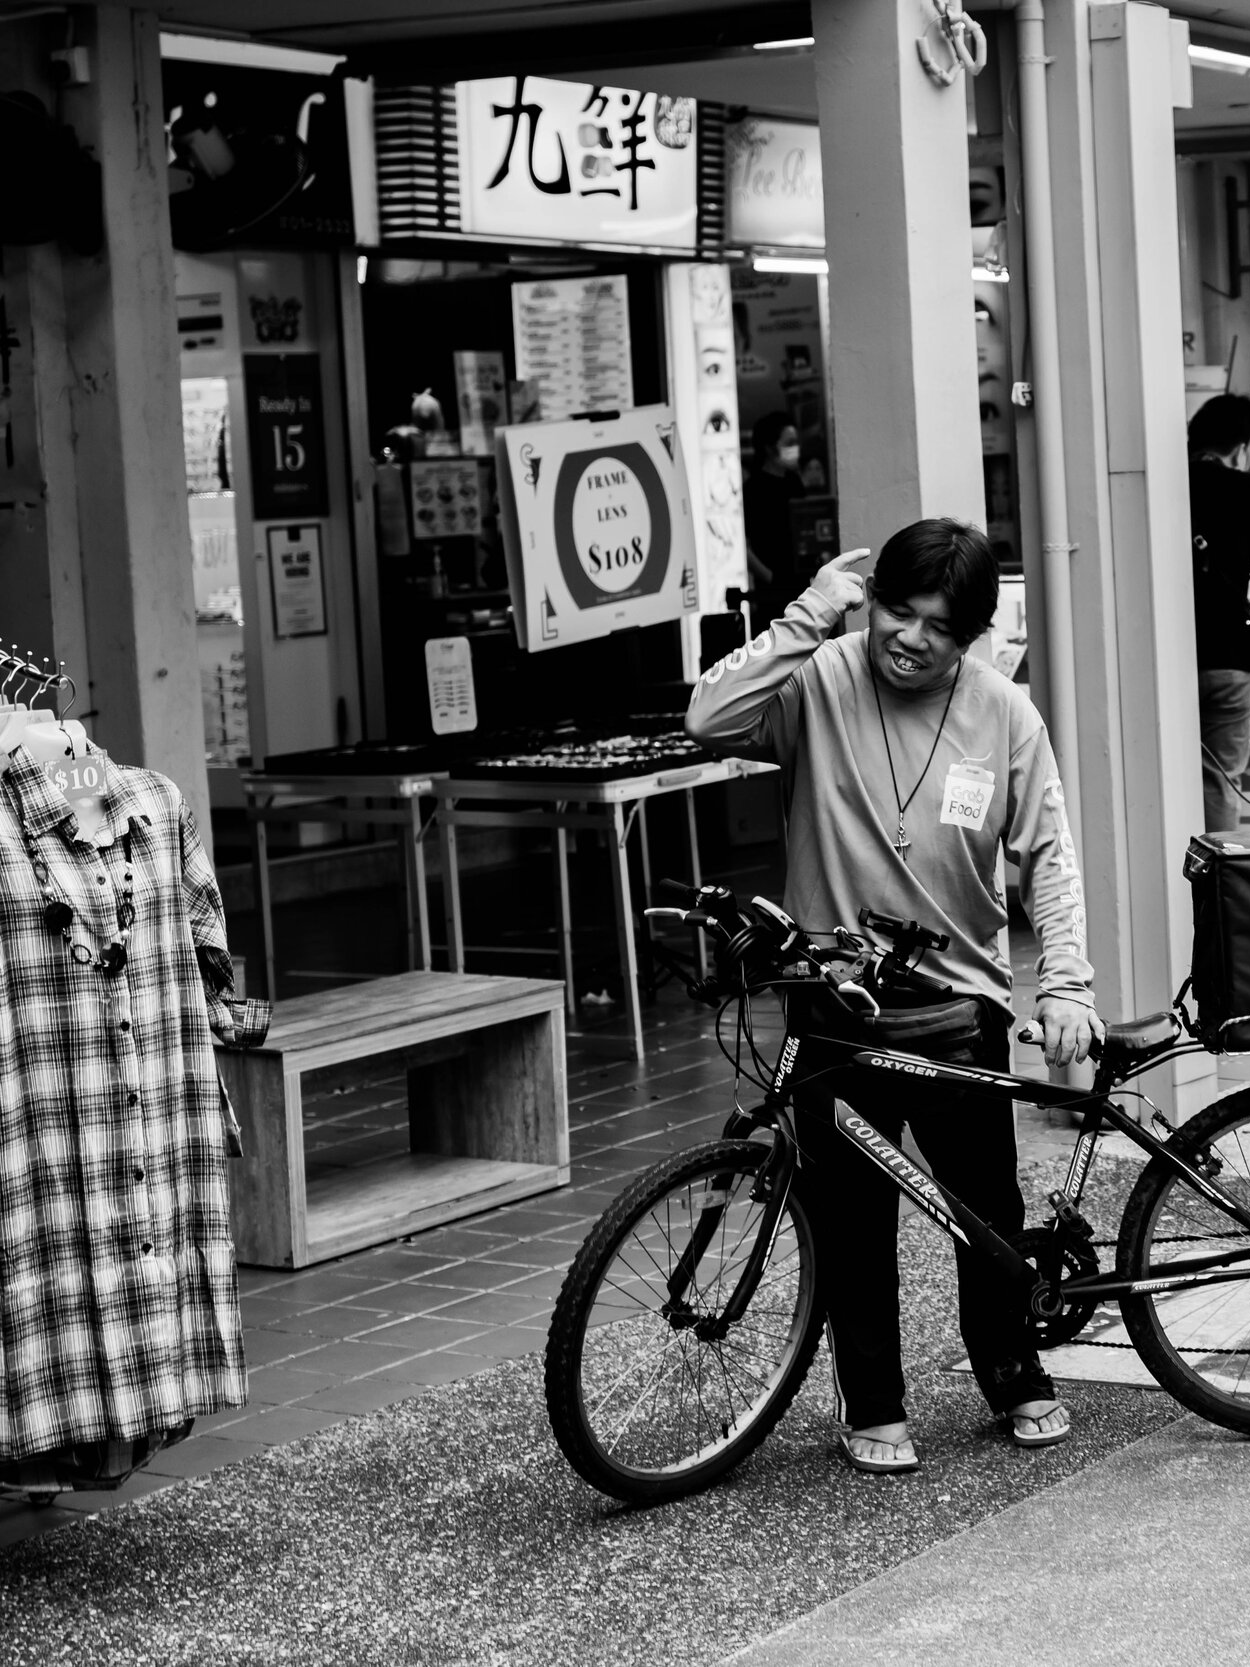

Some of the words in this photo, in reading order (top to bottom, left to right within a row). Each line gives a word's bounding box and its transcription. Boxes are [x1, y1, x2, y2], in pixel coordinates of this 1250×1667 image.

[272, 425, 306, 471] 15
[587, 470, 628, 490] FRAME
[597, 505, 628, 522] LENS
[588, 536, 643, 574] $108
[54, 766, 98, 793] $10
[951, 786, 985, 804] Grab
[949, 800, 982, 819] Food
[787, 1037, 801, 1074] OXYGEN
[870, 1057, 938, 1078] OXYGEN
[845, 1117, 938, 1199] COLATTER
[1070, 1136, 1092, 1198] COLATTER
